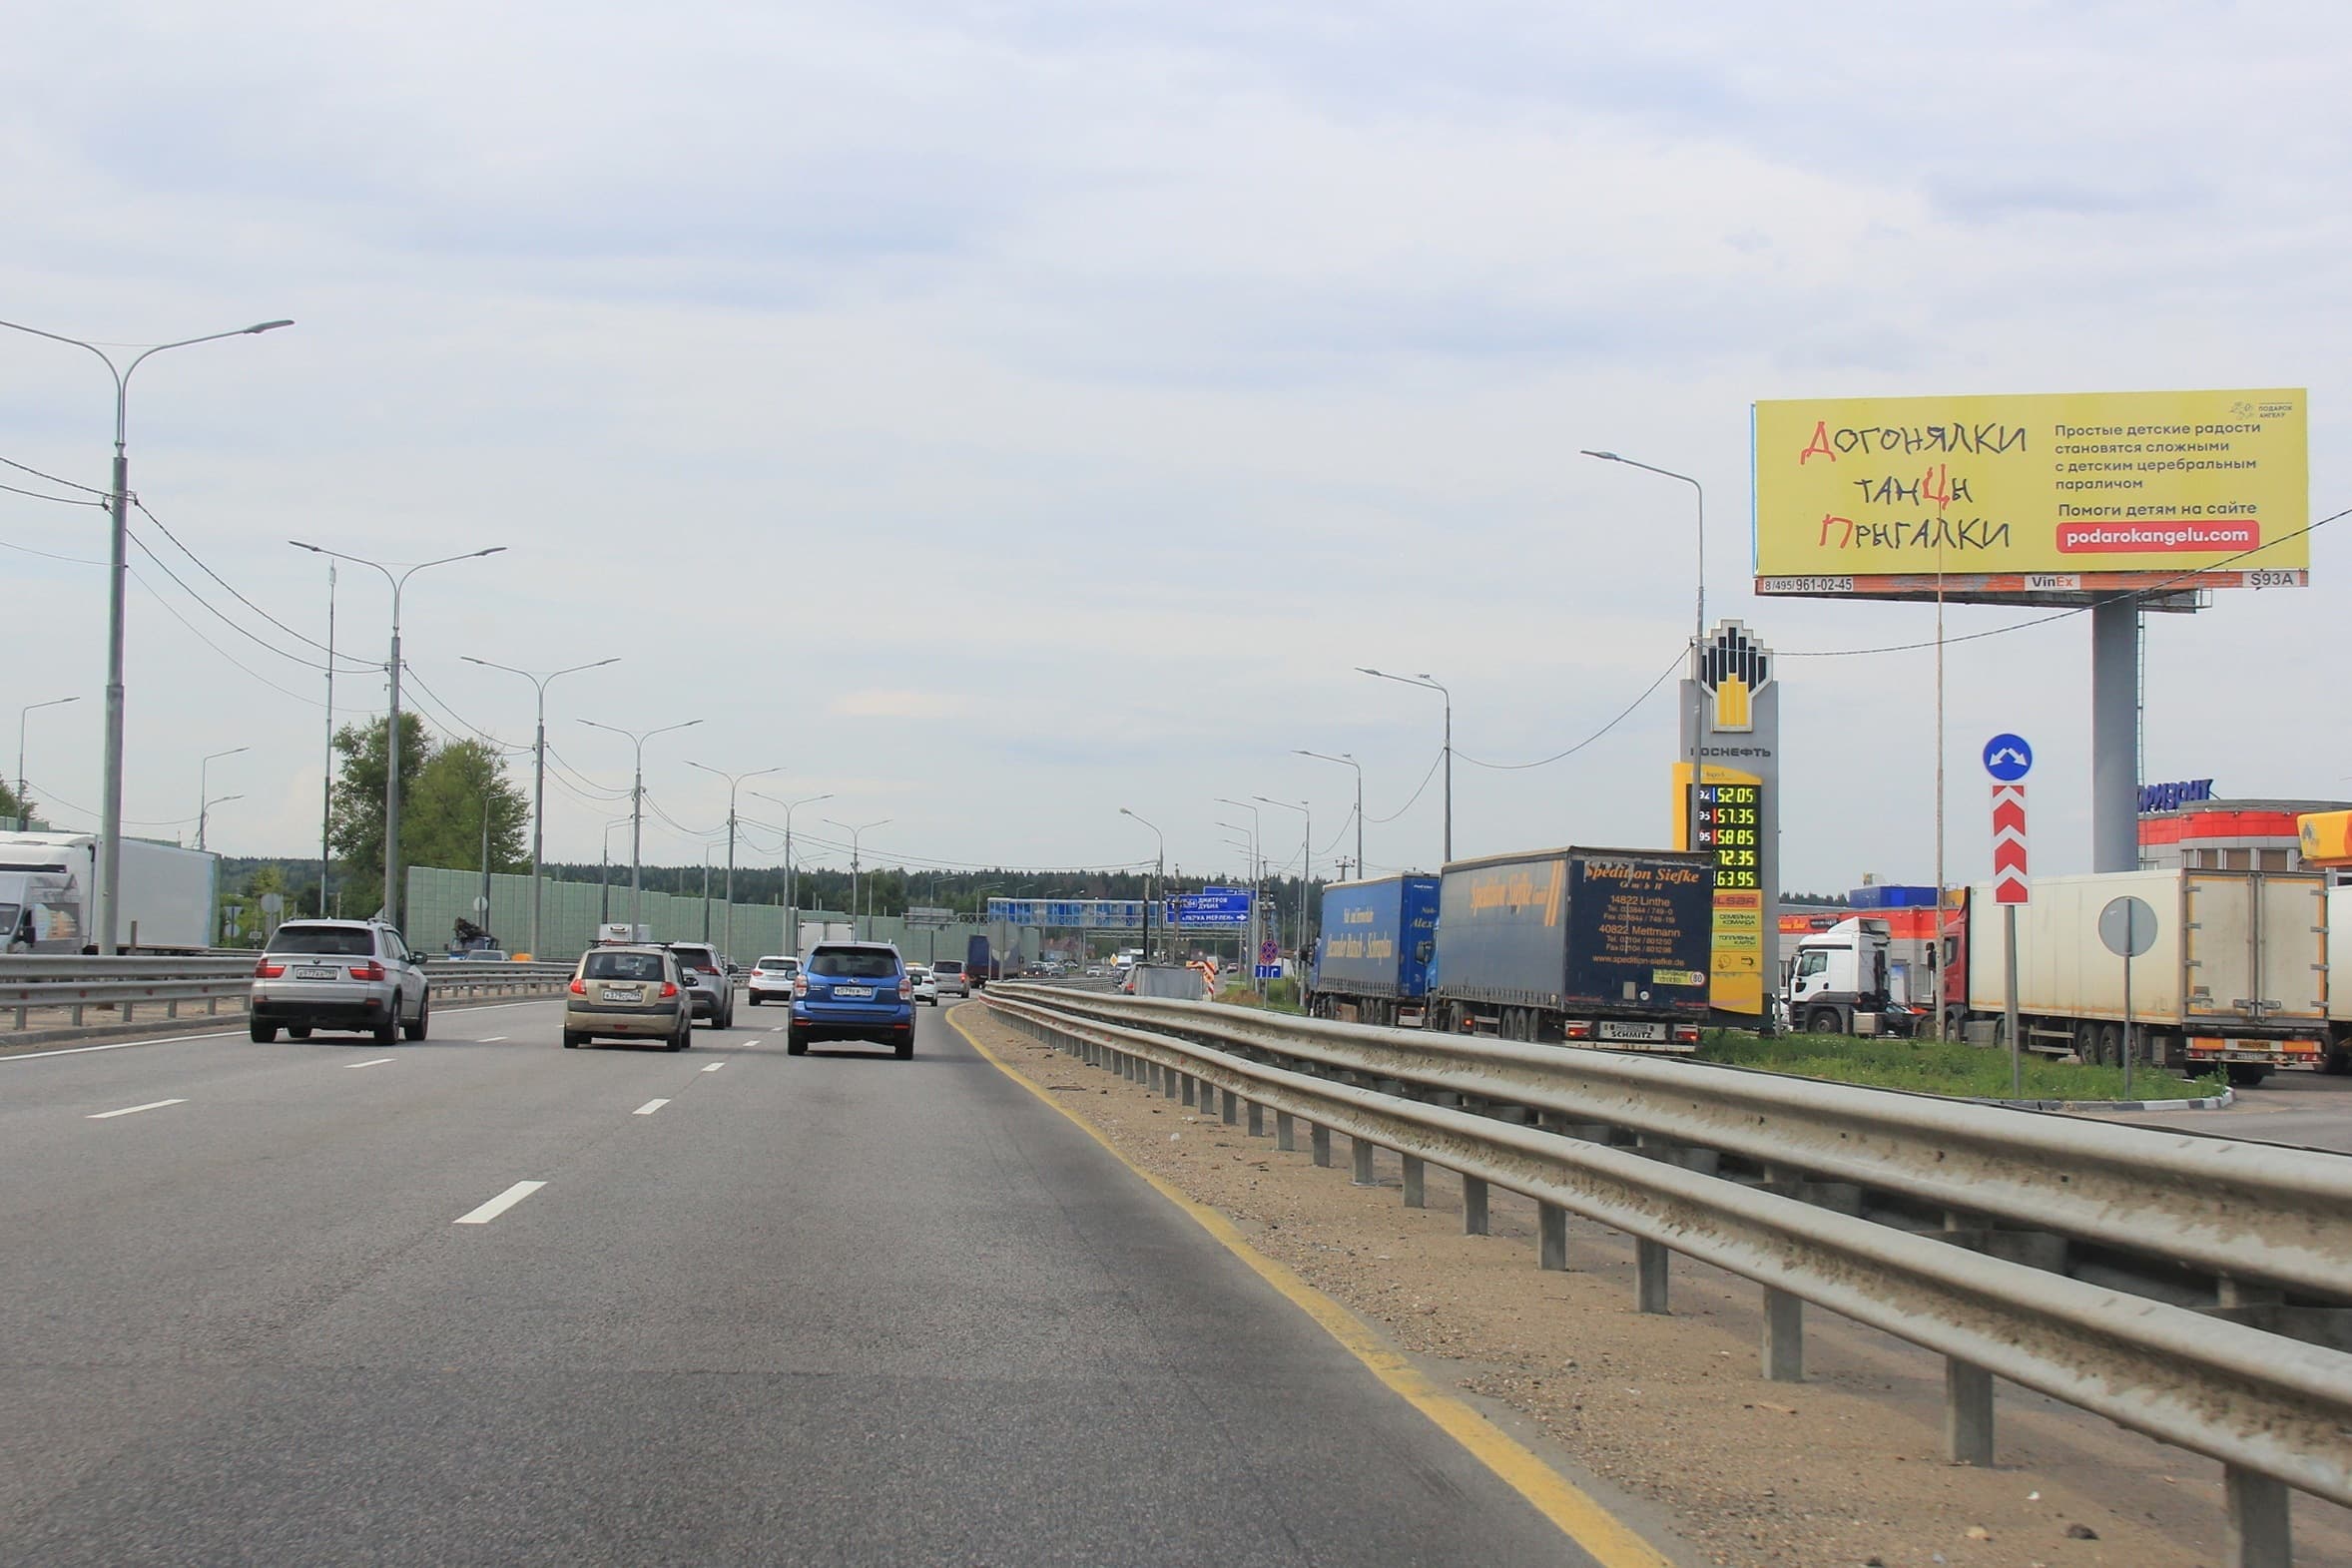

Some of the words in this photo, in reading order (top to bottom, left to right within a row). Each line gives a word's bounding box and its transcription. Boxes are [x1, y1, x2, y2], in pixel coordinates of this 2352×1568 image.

[2055, 424, 2123, 438] Простые
[2126, 424, 2190, 437] детские
[2194, 422, 2261, 436] радости
[1800, 421, 2026, 465] ДОГОНЯЛКИ
[2055, 443, 2141, 454] становятся
[2145, 441, 2229, 453] сложными
[2055, 463, 2063, 472] с
[2067, 460, 2132, 474] детским
[2136, 458, 2256, 473] церебральным
[2056, 478, 2143, 492] параличом
[2058, 504, 2121, 517] Помоги
[2125, 504, 2176, 517] детям
[2181, 504, 2202, 516] на
[2206, 502, 2256, 515] сайте
[1819, 514, 2010, 550] ПРЫГАЛКИ
[2066, 527, 2249, 547] podarokangelu.com
[2032, 575, 2073, 588] VinEx
[2250, 573, 2294, 586] S93A
[1717, 808, 1754, 823] 57.35
[1699, 831, 1711, 841] 95
[1718, 850, 1754, 865] 72.35
[1657, 868, 1699, 884] Siefke
[1640, 896, 1670, 907] Linthe
[1599, 924, 1629, 934] 40822
[1632, 925, 1680, 937] Mettmann
